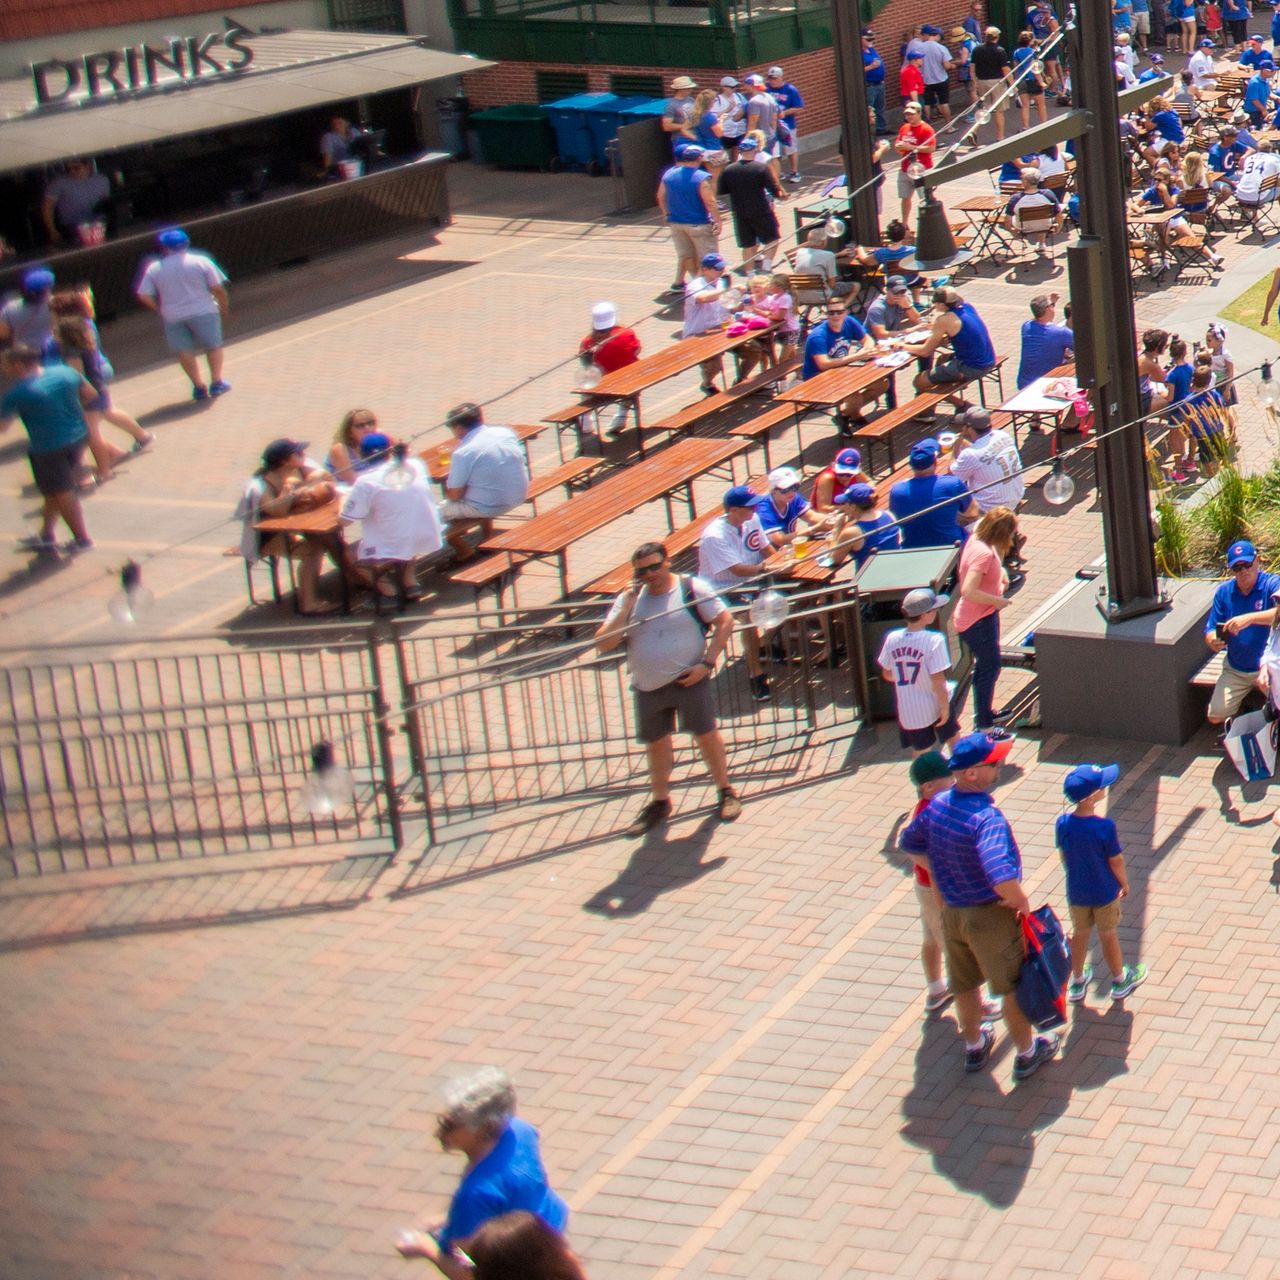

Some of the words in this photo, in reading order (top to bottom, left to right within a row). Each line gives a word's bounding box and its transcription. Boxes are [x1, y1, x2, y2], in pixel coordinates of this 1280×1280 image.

[31, 26, 255, 106] DRINKS
[1246, 161, 1266, 175] 34
[891, 646, 924, 661] BRYANT
[895, 661, 921, 687] 17
